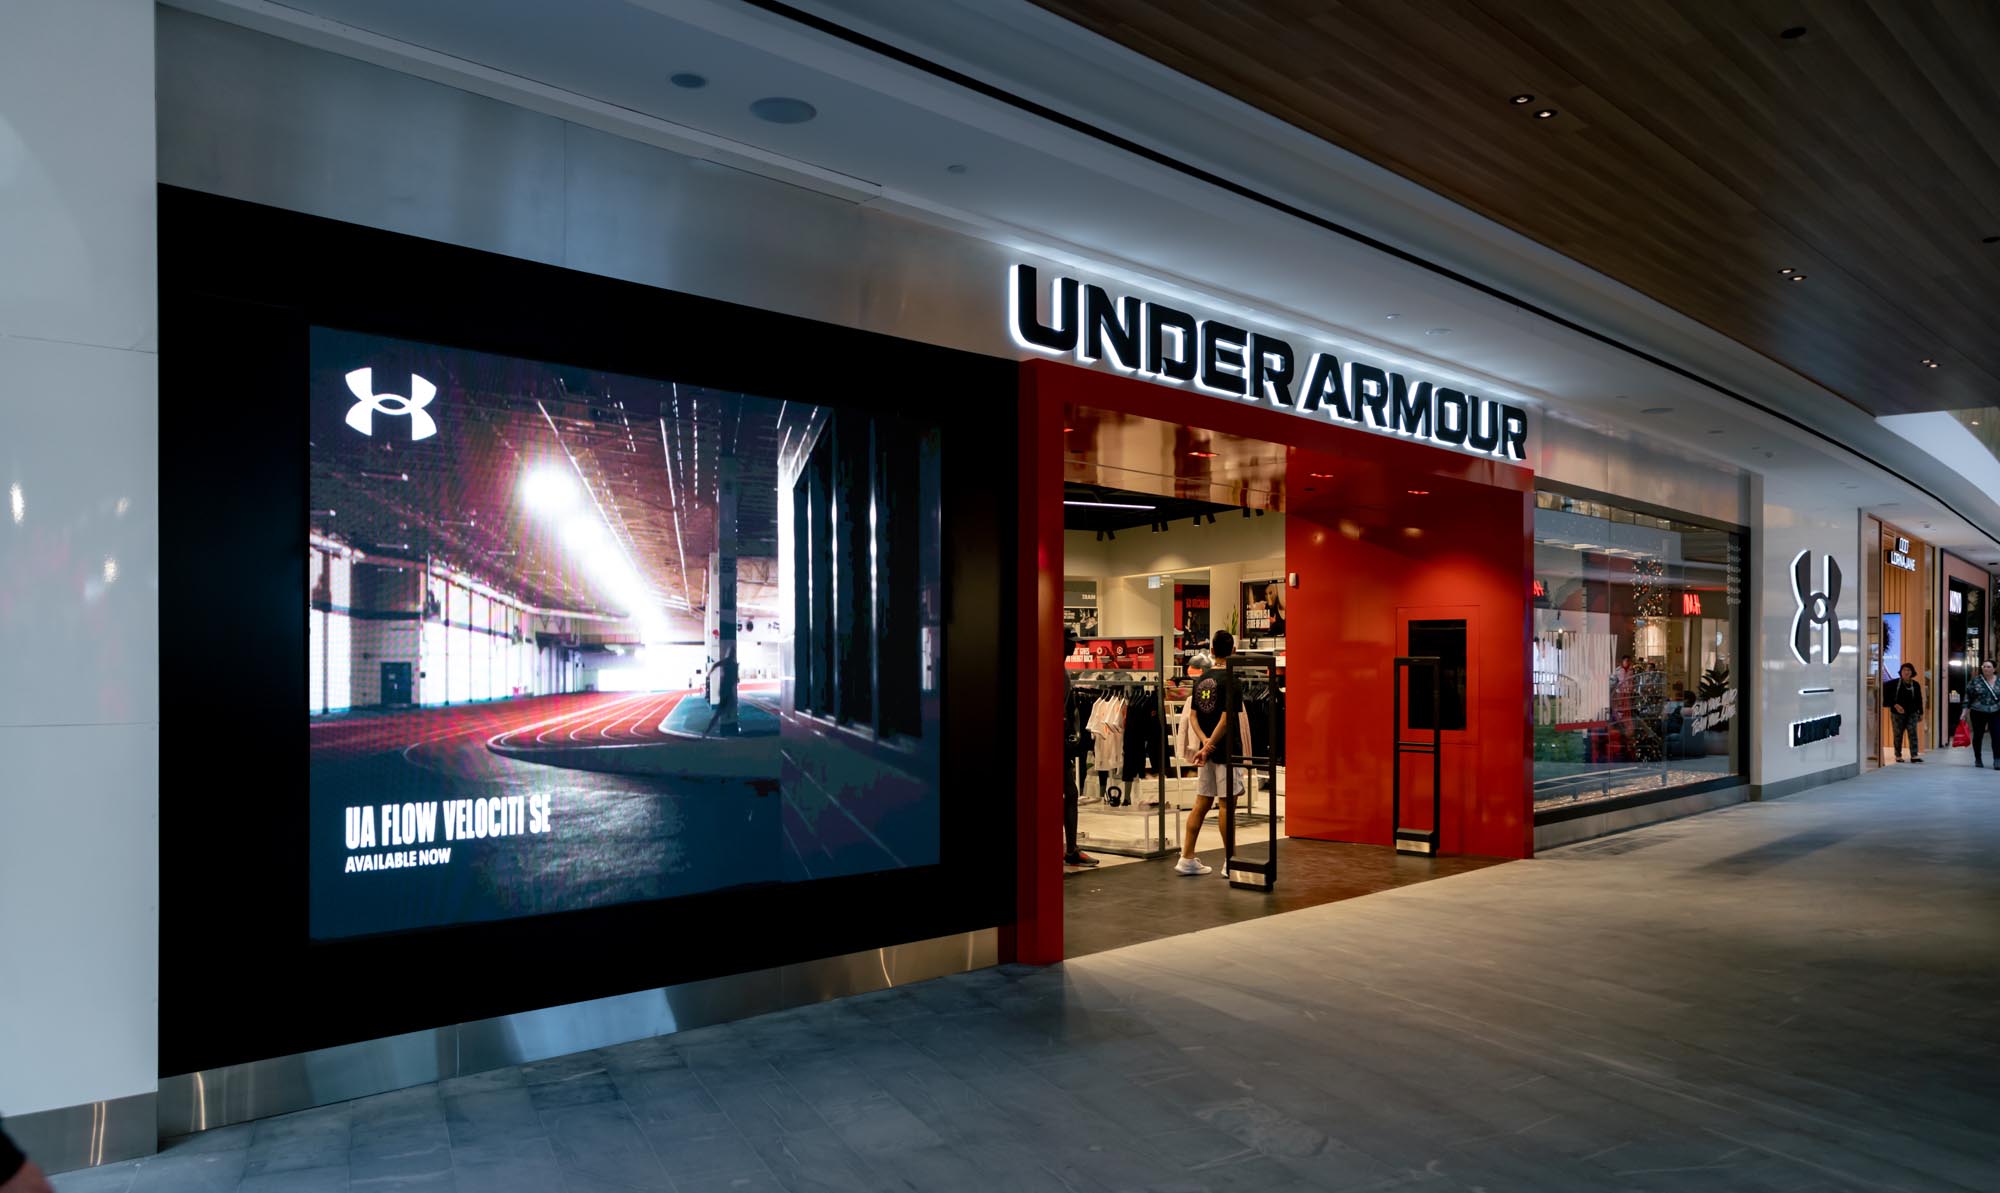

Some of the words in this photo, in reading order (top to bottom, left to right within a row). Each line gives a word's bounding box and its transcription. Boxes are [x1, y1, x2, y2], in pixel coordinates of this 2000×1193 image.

[1009, 263, 1296, 406] UNDER
[1297, 352, 1529, 462] ARMOUR
[345, 805, 376, 849] UA
[381, 801, 437, 847] FLOW
[443, 795, 525, 841] VELOCITI
[529, 793, 552, 834] SE
[344, 850, 417, 873] AVAILABLE
[419, 848, 452, 866] NOW
